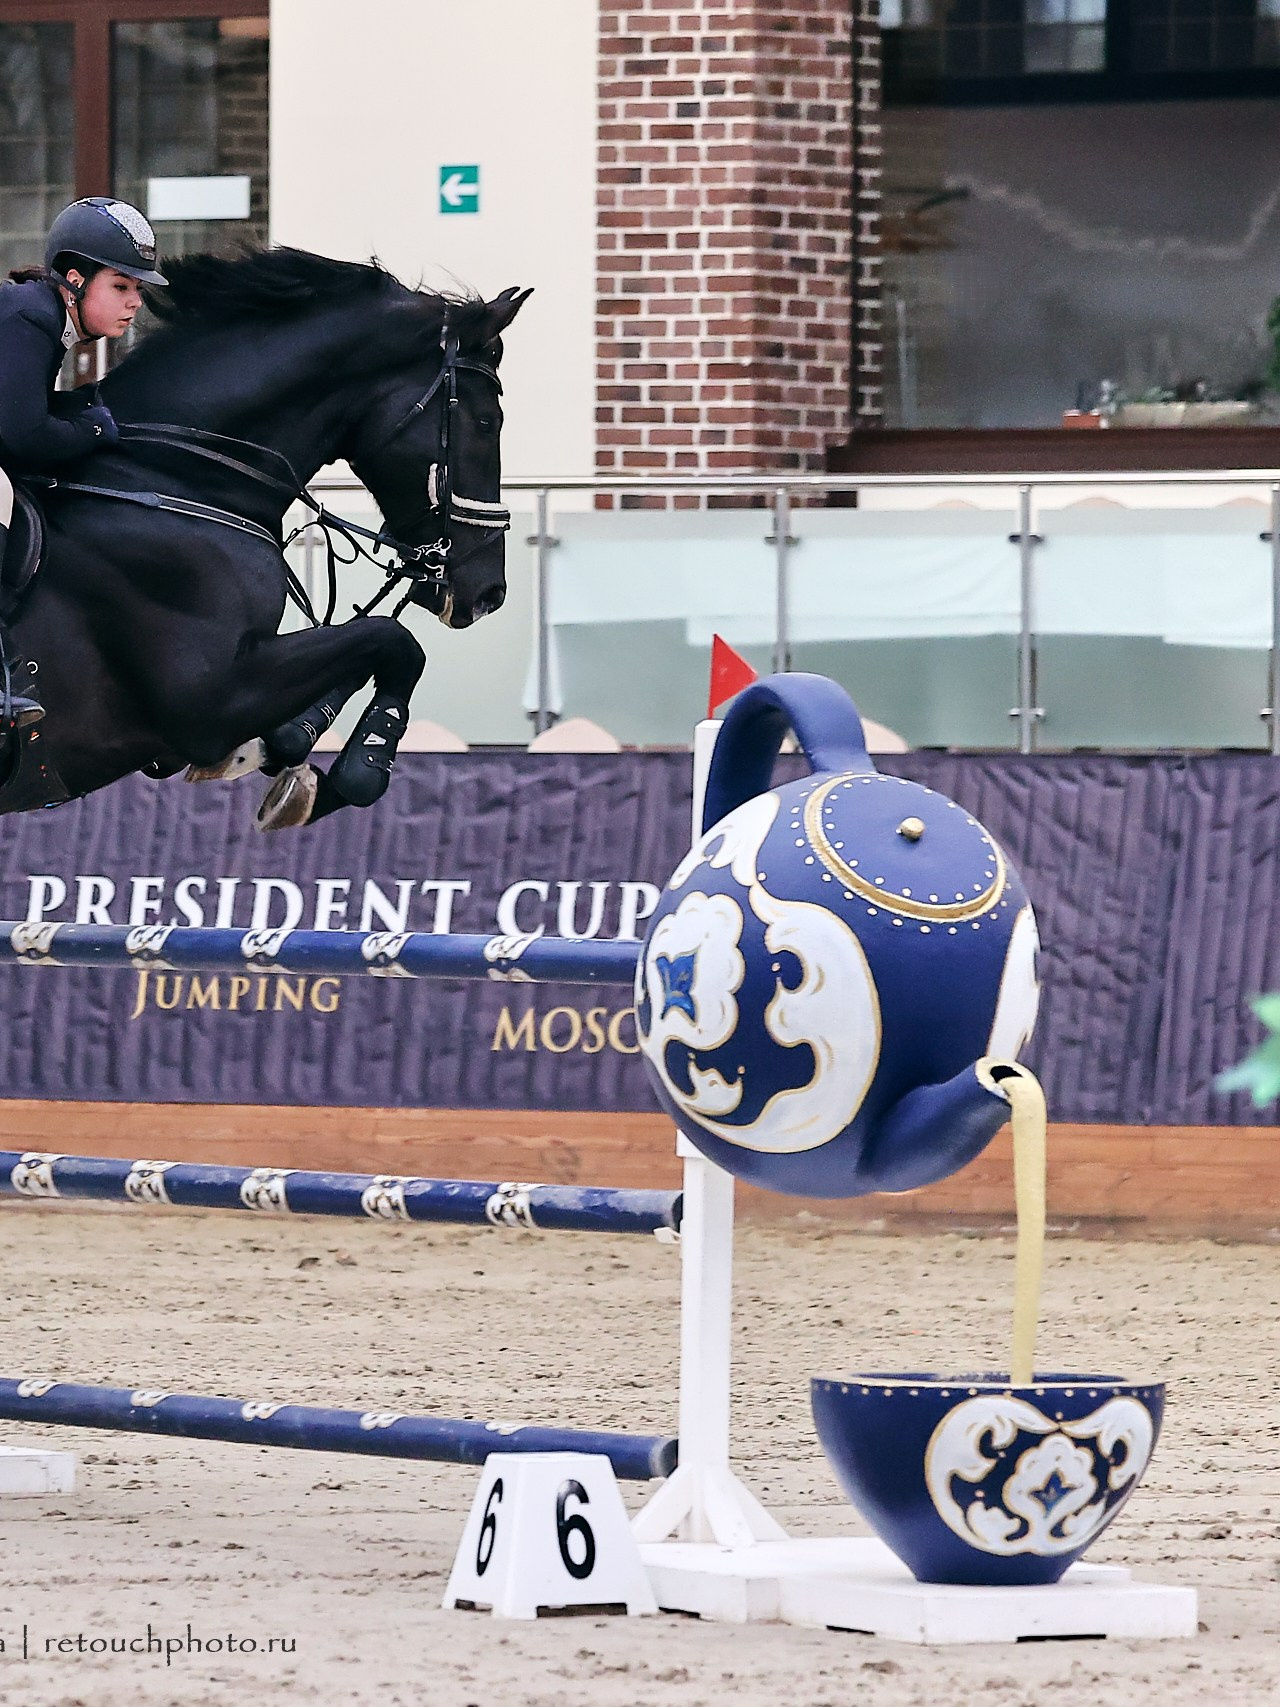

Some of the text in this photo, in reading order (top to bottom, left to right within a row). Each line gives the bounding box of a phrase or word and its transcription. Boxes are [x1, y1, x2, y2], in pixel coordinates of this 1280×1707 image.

[27, 875, 472, 935] PRESIDENT
[496, 879, 662, 940] CUP
[476, 1478, 504, 1577] 6
[556, 1479, 596, 1580] 6
